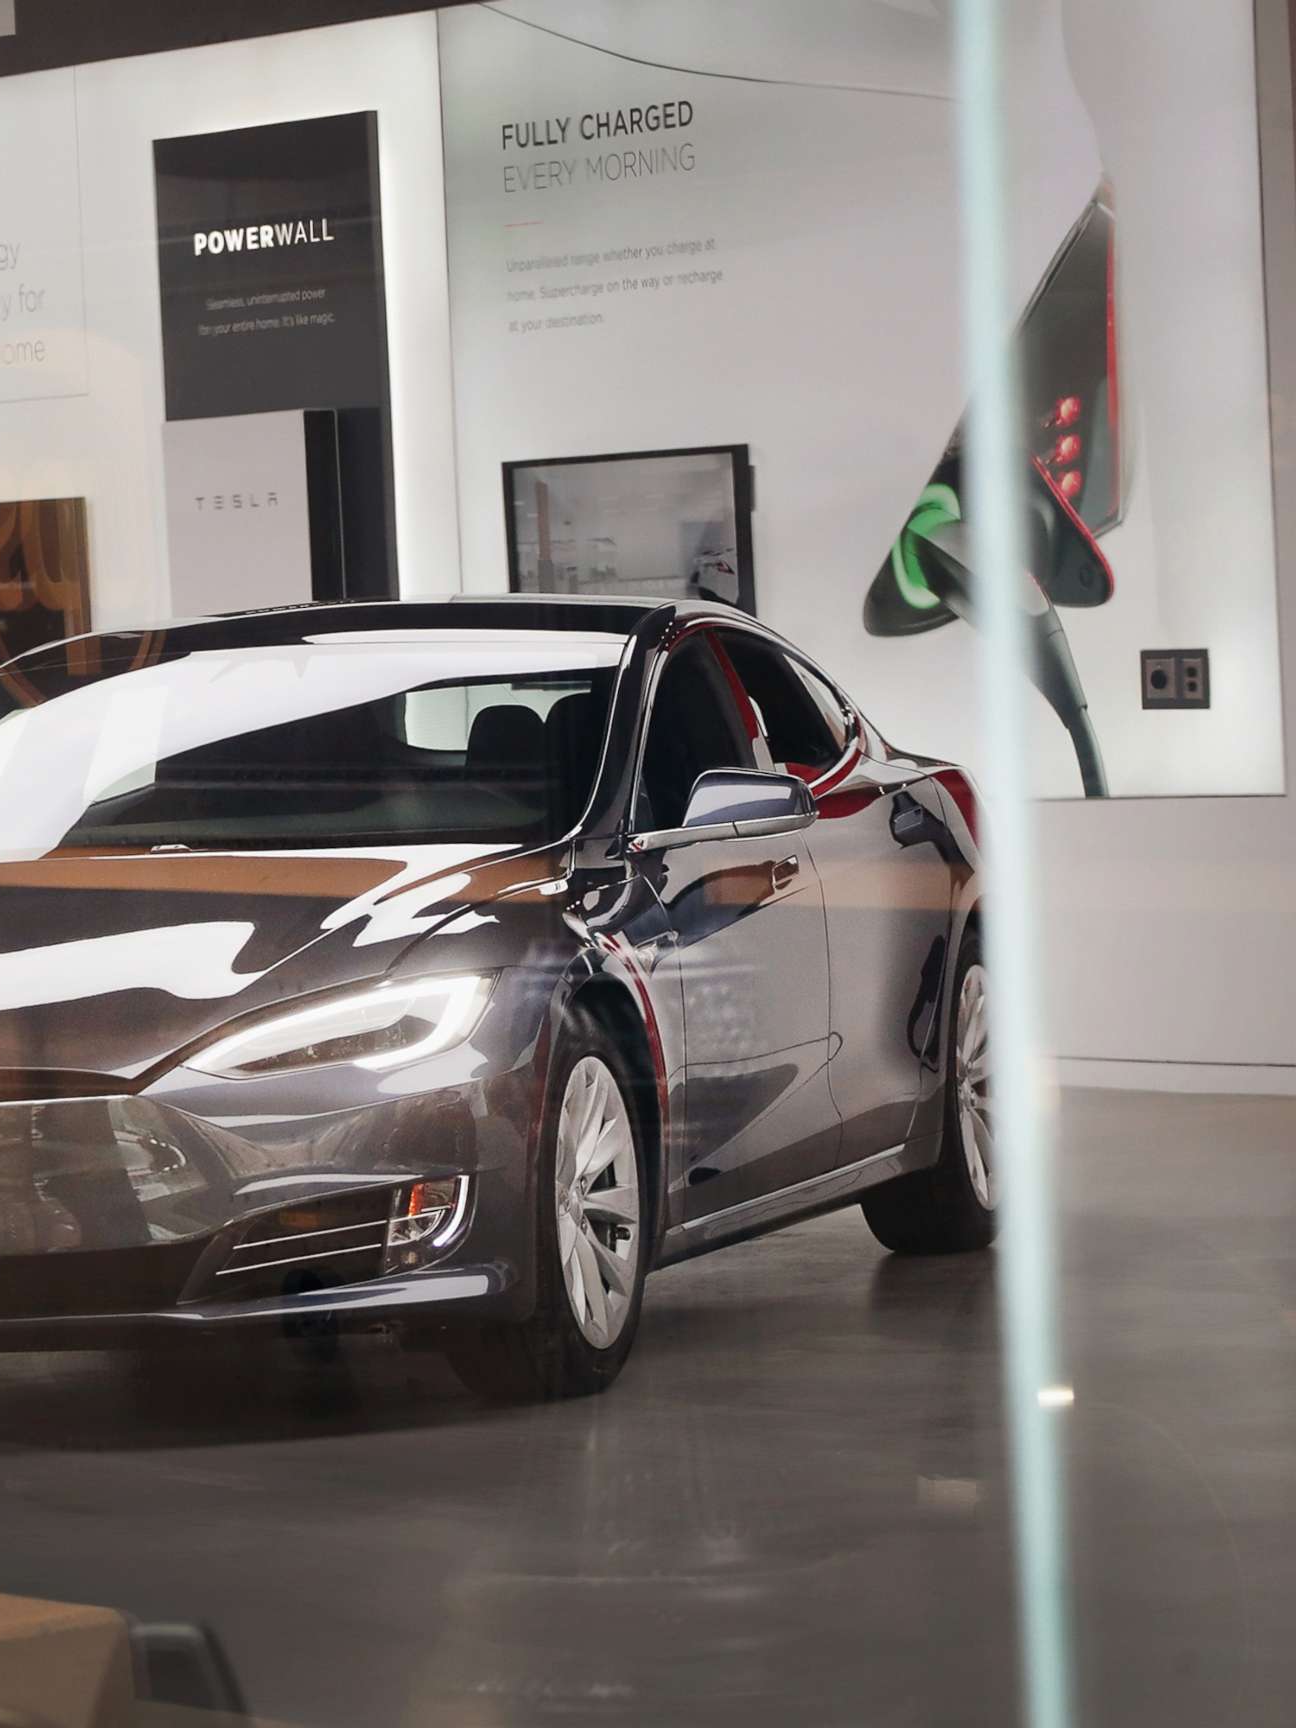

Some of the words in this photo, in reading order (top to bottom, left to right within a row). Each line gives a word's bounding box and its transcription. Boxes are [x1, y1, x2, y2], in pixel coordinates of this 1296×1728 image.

[502, 116, 571, 150] FULLY
[580, 100, 694, 140] CHARGED
[503, 157, 577, 193] EVERY
[585, 143, 696, 182] MORNING
[194, 217, 336, 256] POWERWALL
[601, 244, 642, 261] whether
[644, 246, 664, 261] you
[666, 239, 703, 256] charge
[705, 237, 716, 250] at
[606, 280, 621, 293] on
[622, 277, 639, 292] the
[640, 276, 661, 291] way
[663, 274, 675, 286] or
[17, 282, 46, 313] for
[301, 288, 325, 303] power
[212, 322, 231, 339] your
[520, 319, 542, 335] your
[195, 491, 279, 511] TESLA
